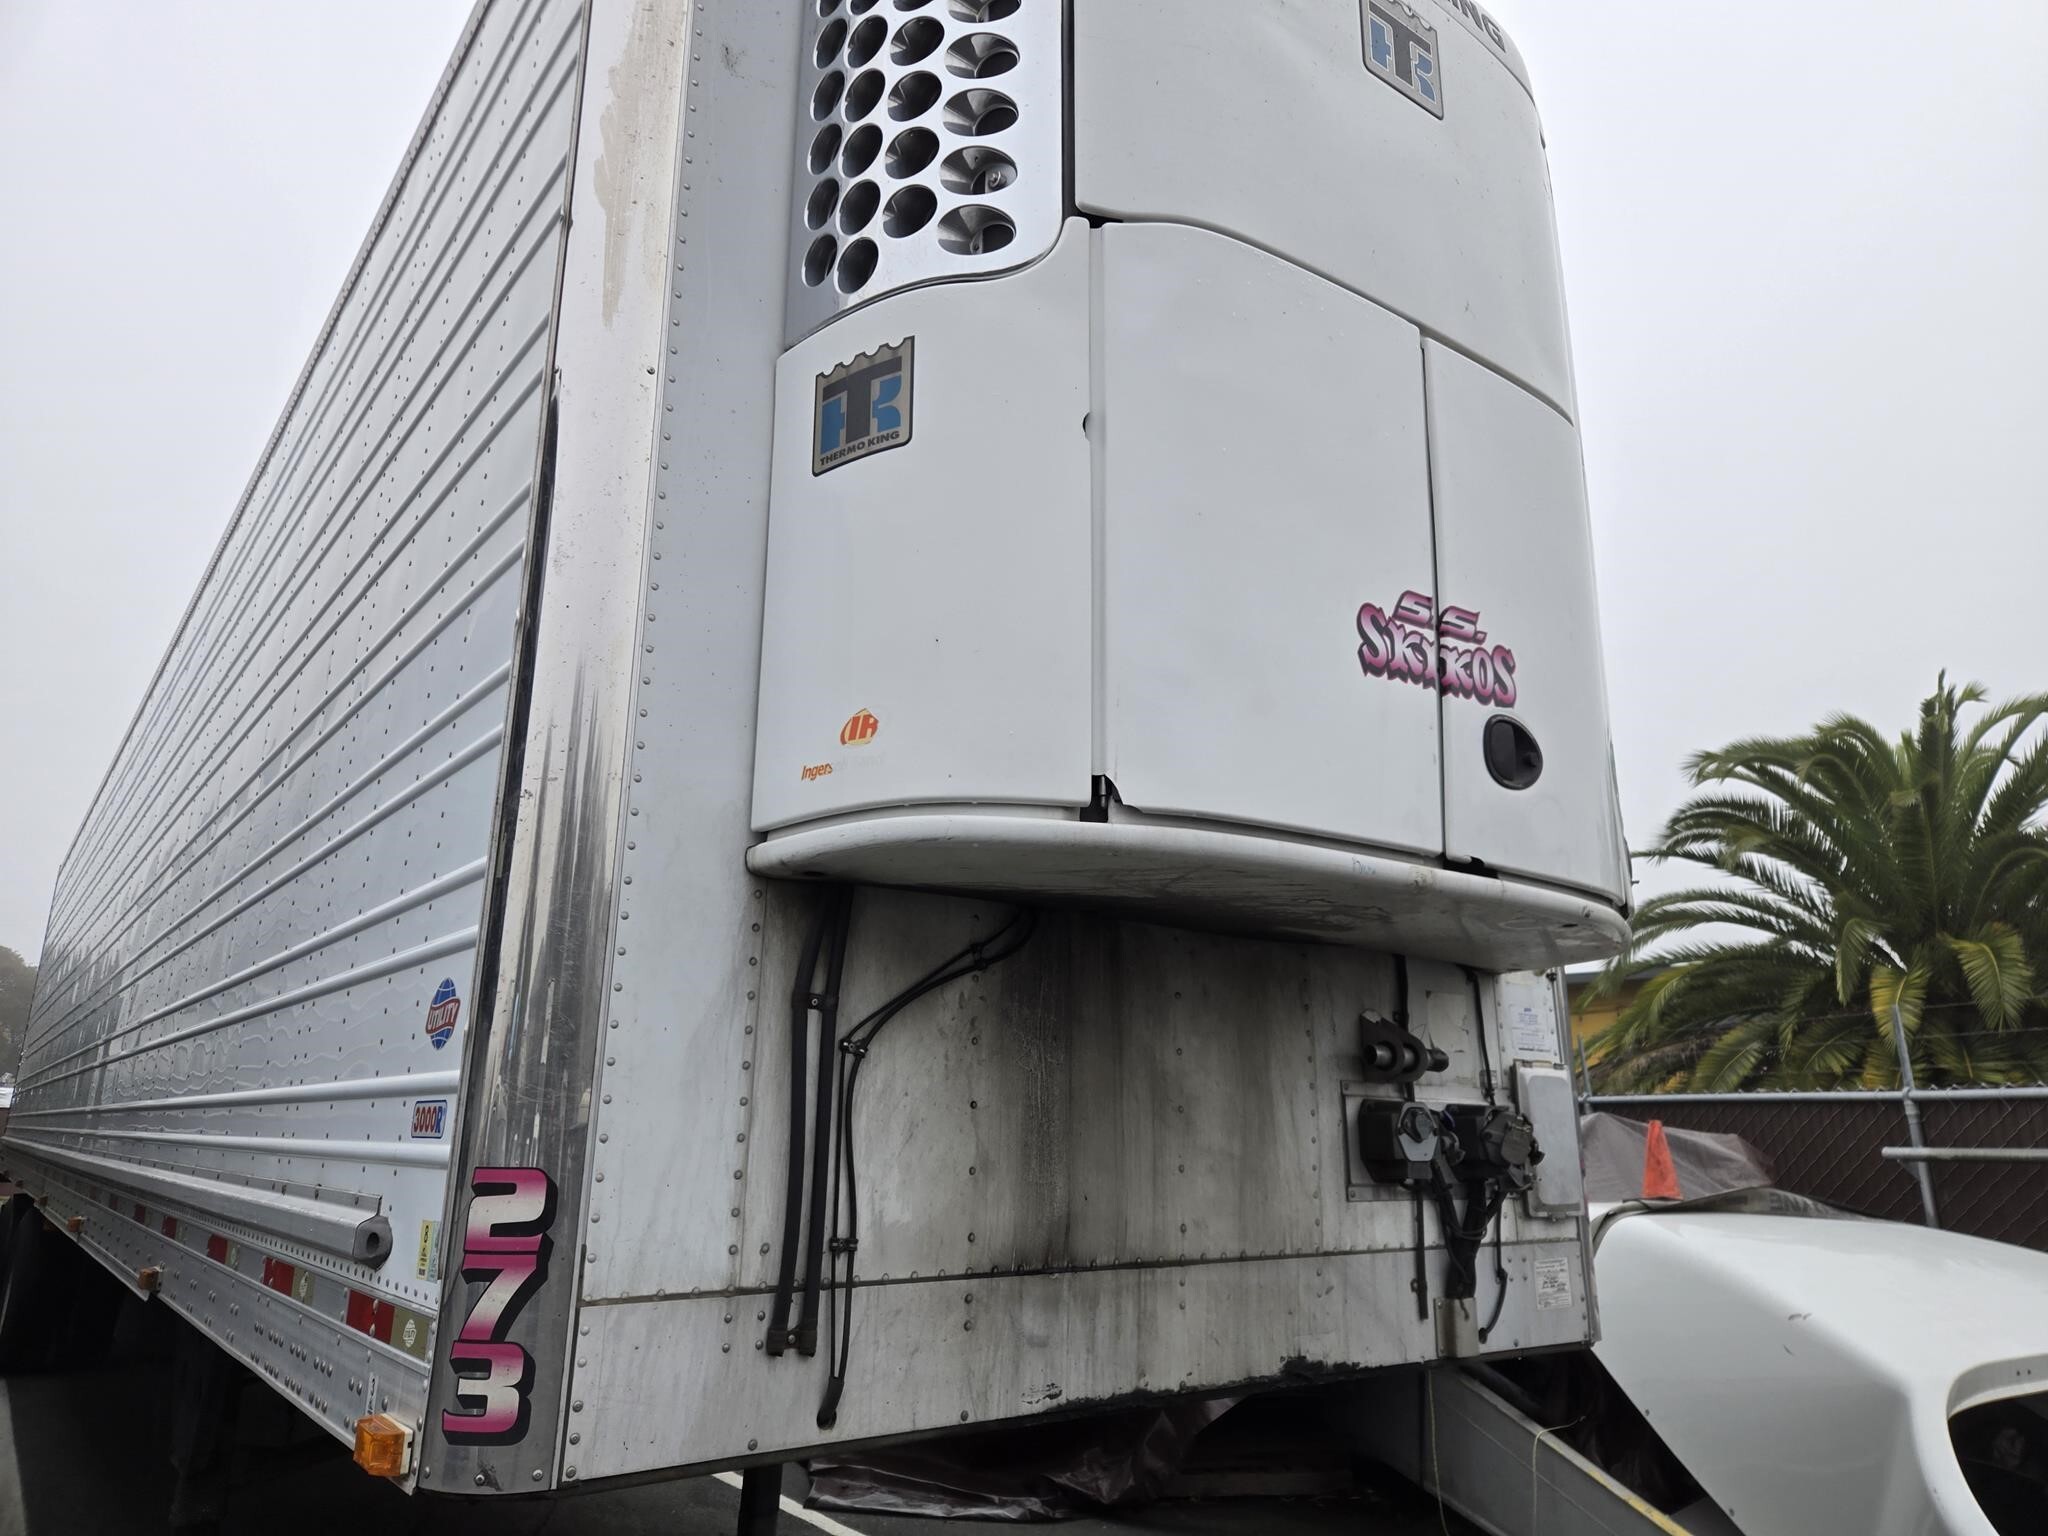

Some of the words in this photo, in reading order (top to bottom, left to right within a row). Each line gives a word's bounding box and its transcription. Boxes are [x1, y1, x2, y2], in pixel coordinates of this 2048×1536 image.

[820, 441, 866, 466] THERMO
[867, 430, 901, 448] KING
[428, 1000, 460, 1032] UTILITY
[442, 1166, 559, 1447] 273
